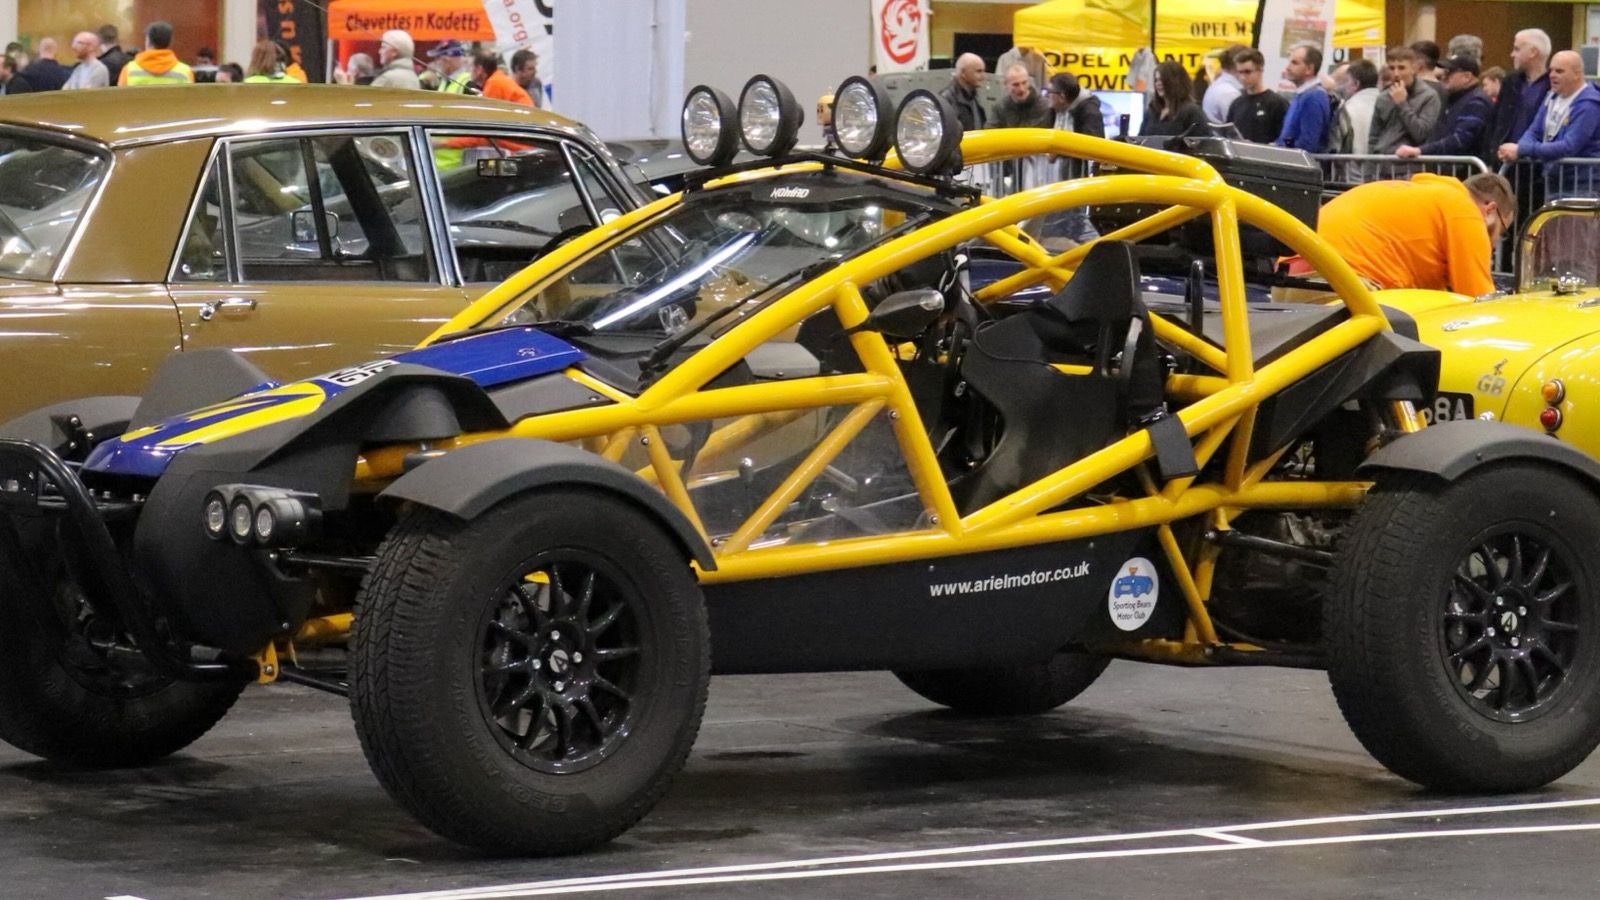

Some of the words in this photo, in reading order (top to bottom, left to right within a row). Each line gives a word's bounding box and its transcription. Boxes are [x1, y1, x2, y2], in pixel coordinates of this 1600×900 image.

[346, 13, 410, 31] Chevettes
[414, 16, 423, 30] n
[427, 12, 480, 31] Kadetts
[1191, 22, 1230, 37] OPEL
[1044, 52, 1110, 67] OPEL
[1477, 374, 1506, 395] GB
[930, 561, 1090, 597] www.arielmotor.co.uk
[1113, 601, 1136, 611] Sporting
[1117, 612, 1133, 620] Motor
